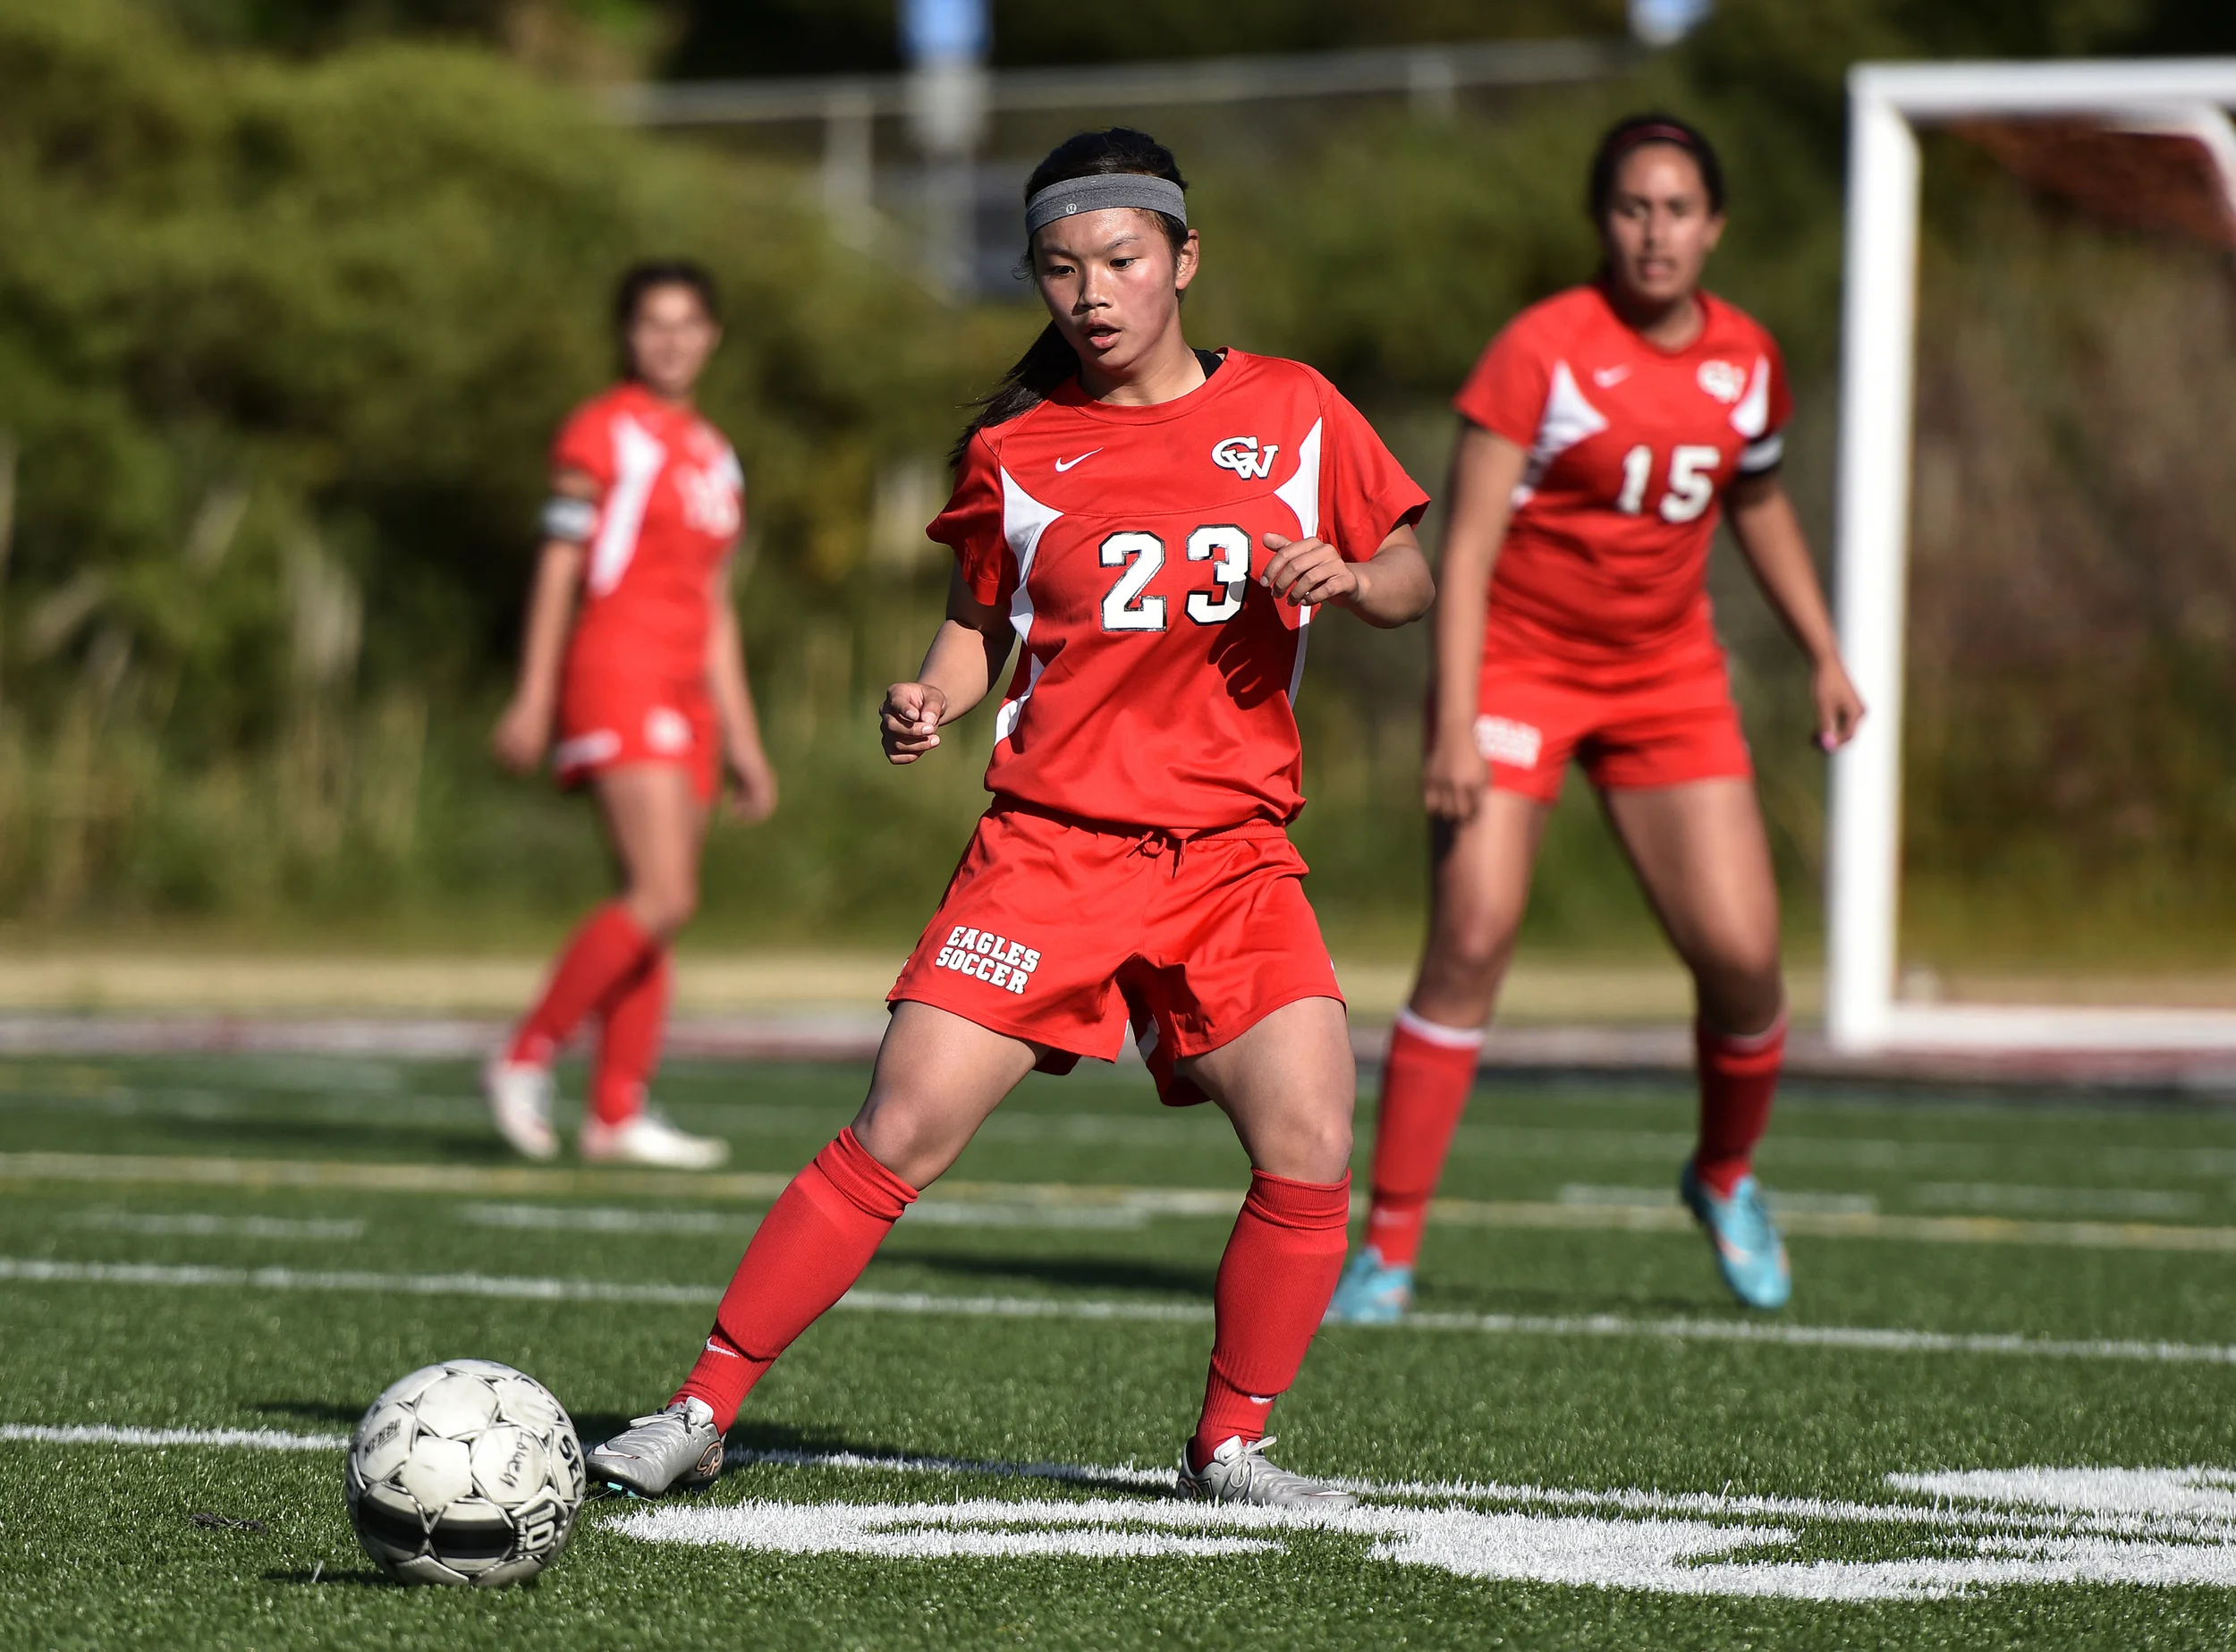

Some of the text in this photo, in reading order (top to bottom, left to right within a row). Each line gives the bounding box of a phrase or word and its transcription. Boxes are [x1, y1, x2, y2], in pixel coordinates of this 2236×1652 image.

[1617, 444, 1720, 524] 15
[1098, 523, 1252, 632] 23
[936, 946, 1029, 995] SOCCER
[946, 926, 1042, 973] EAGLES
[526, 1503, 556, 1550] 10
